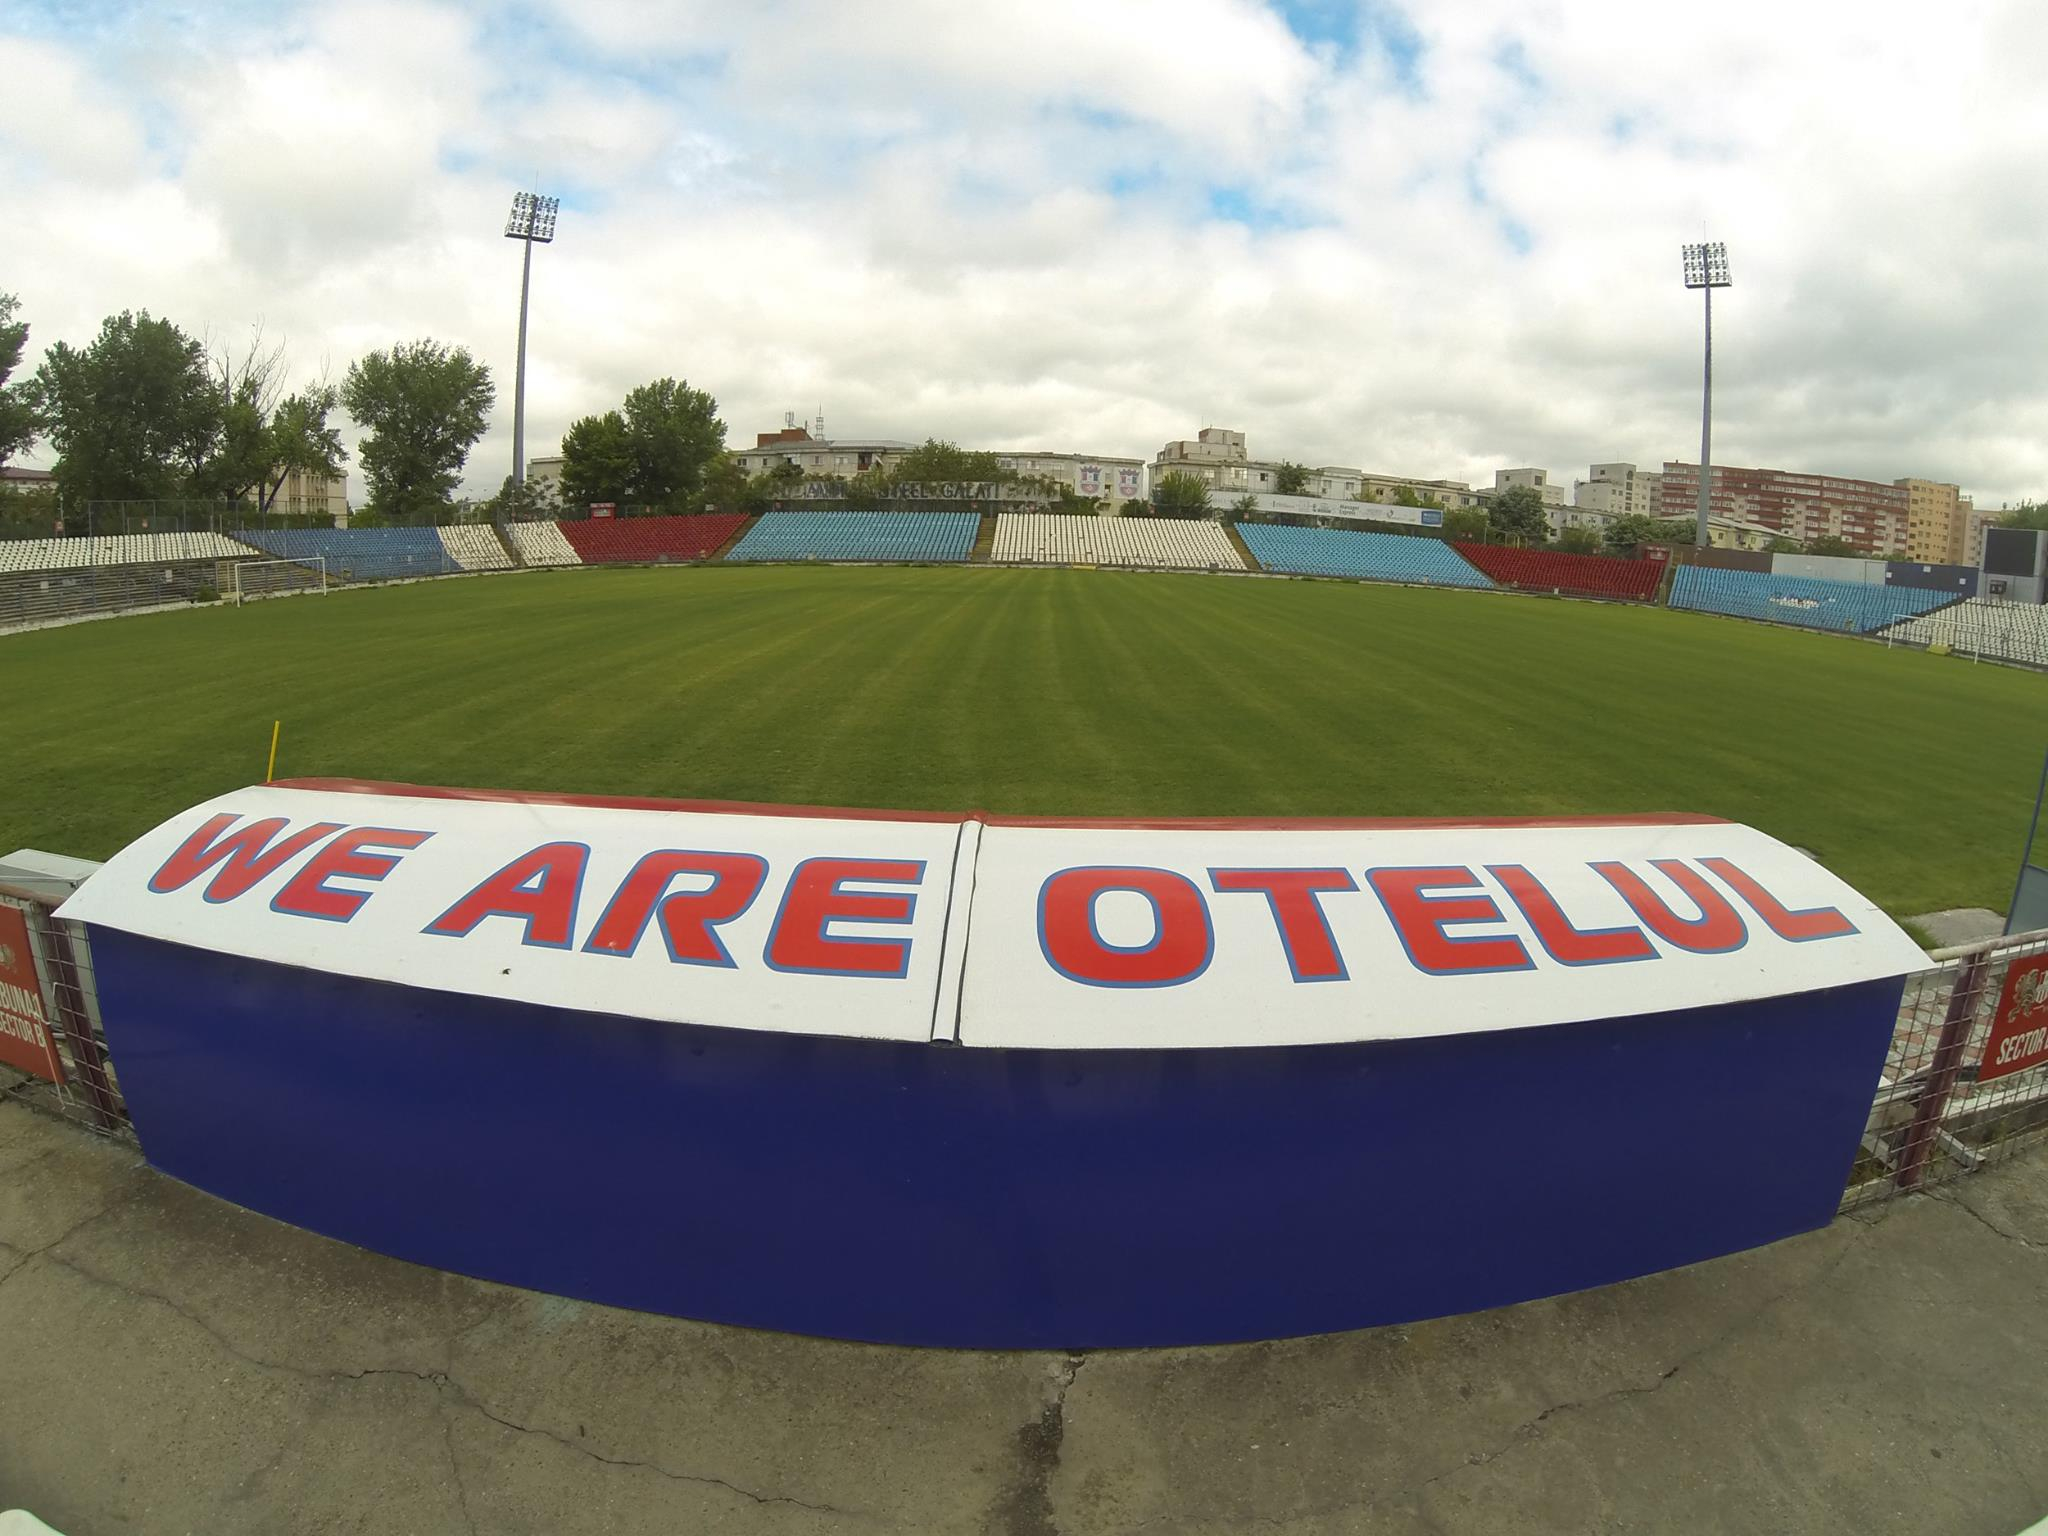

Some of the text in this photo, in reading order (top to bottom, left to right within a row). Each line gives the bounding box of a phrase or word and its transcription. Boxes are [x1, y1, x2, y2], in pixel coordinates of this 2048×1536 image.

[147, 812, 1862, 989] WE ARE OTELUL
[0, 981, 36, 1018] BUNA
[1996, 1026, 2048, 1066] SECTOR
